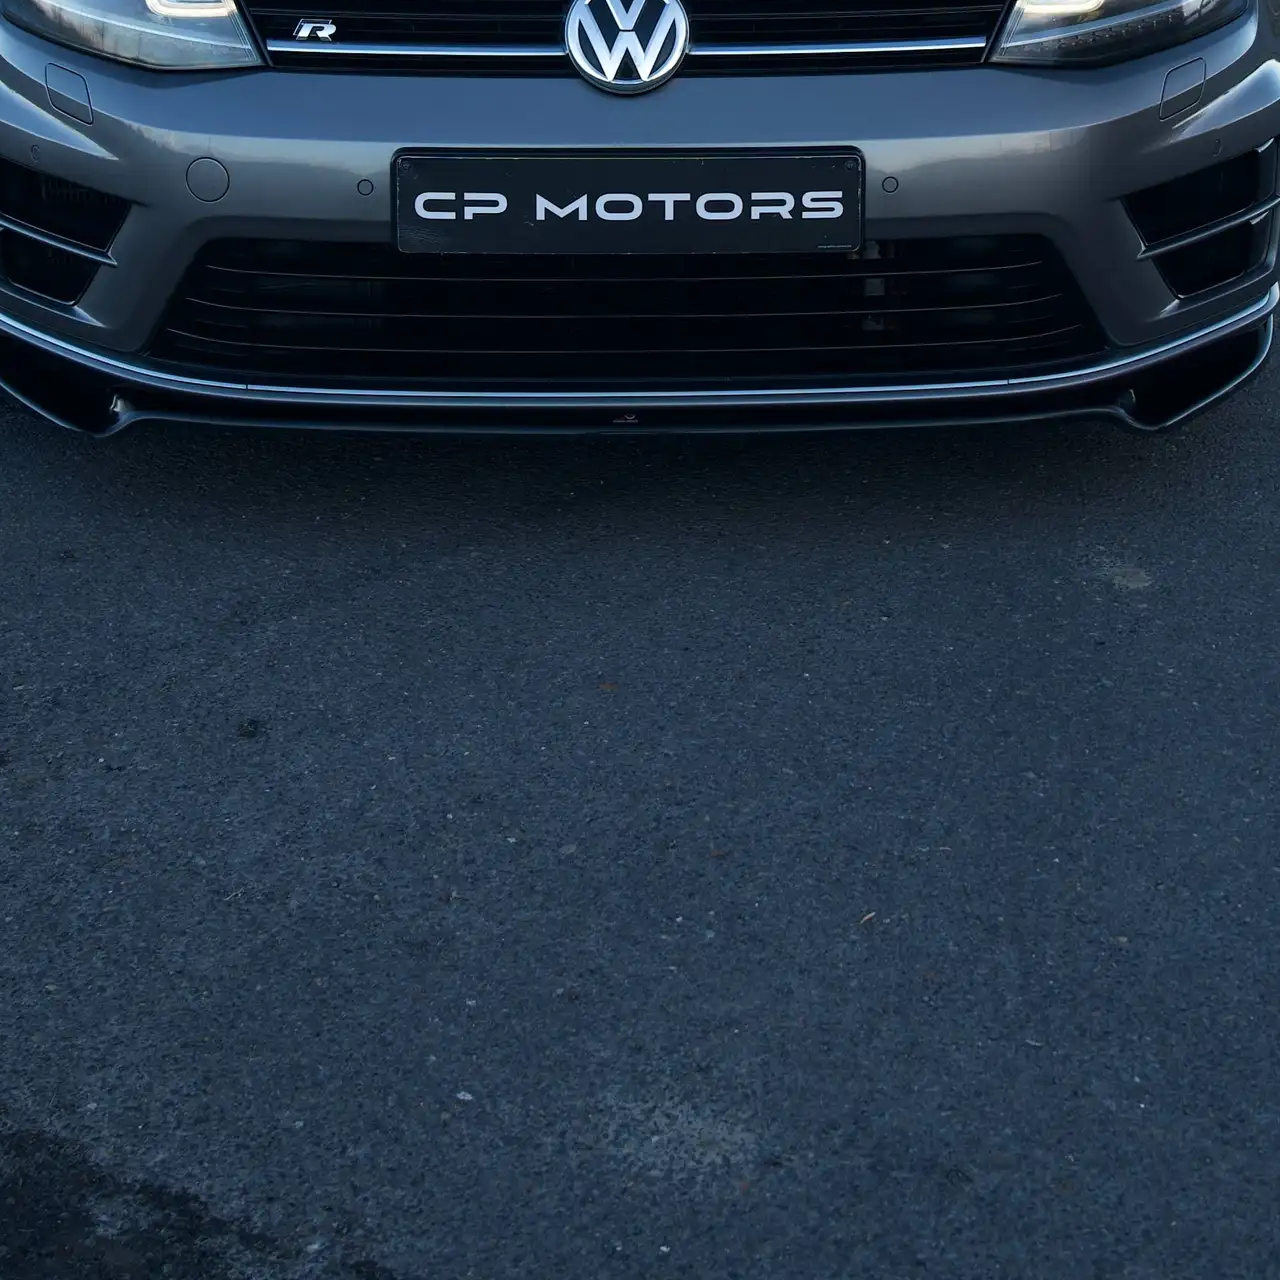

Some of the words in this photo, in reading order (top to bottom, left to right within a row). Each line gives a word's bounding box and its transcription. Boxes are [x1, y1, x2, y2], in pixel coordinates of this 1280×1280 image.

[294, 19, 337, 42] R
[414, 191, 508, 220] CP
[535, 190, 844, 221] MOTORS
